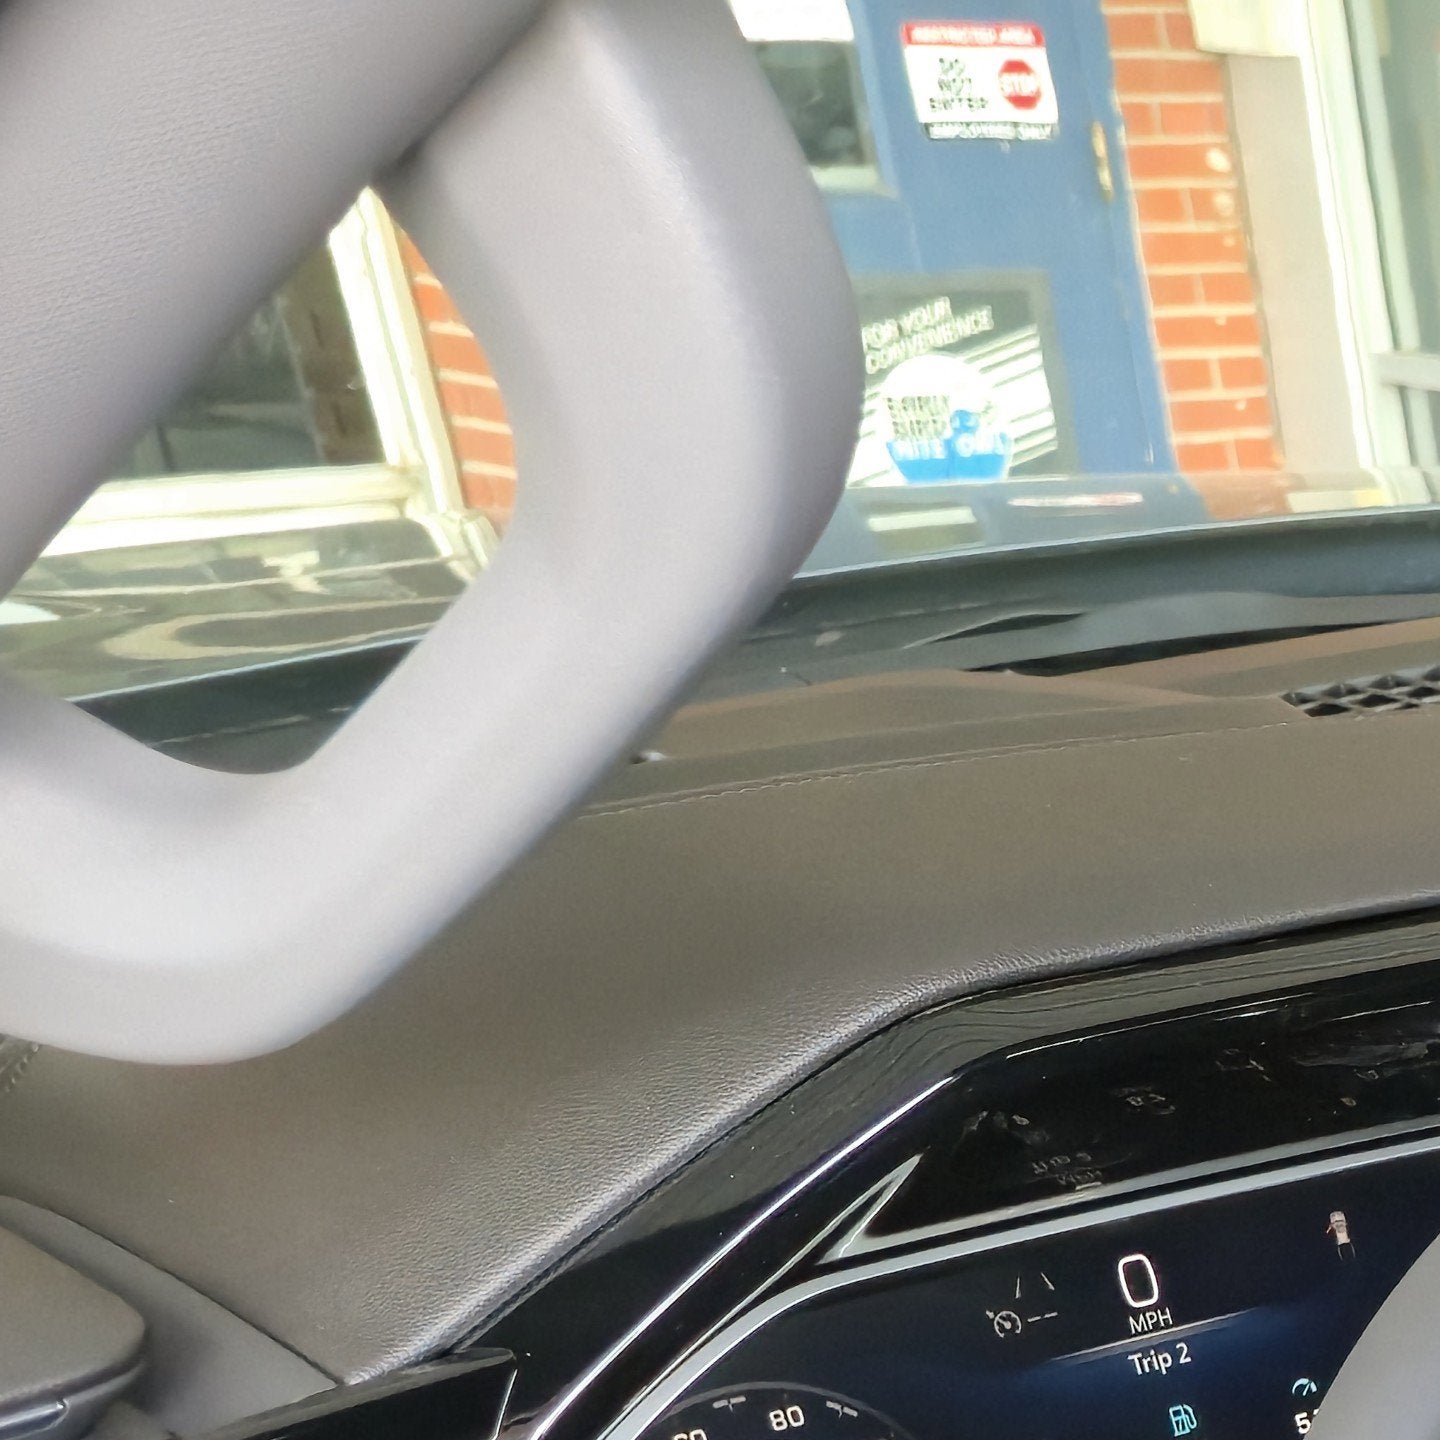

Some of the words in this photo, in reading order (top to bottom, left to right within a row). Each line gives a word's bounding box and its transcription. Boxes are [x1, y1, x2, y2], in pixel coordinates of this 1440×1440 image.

[998, 72, 1042, 97] STOP
[1117, 1251, 1161, 1310] 0
[1129, 1309, 1175, 1335] MPH
[1128, 1349, 1174, 1378] Trip
[1177, 1343, 1191, 1366] 2
[769, 1404, 806, 1432] 80
